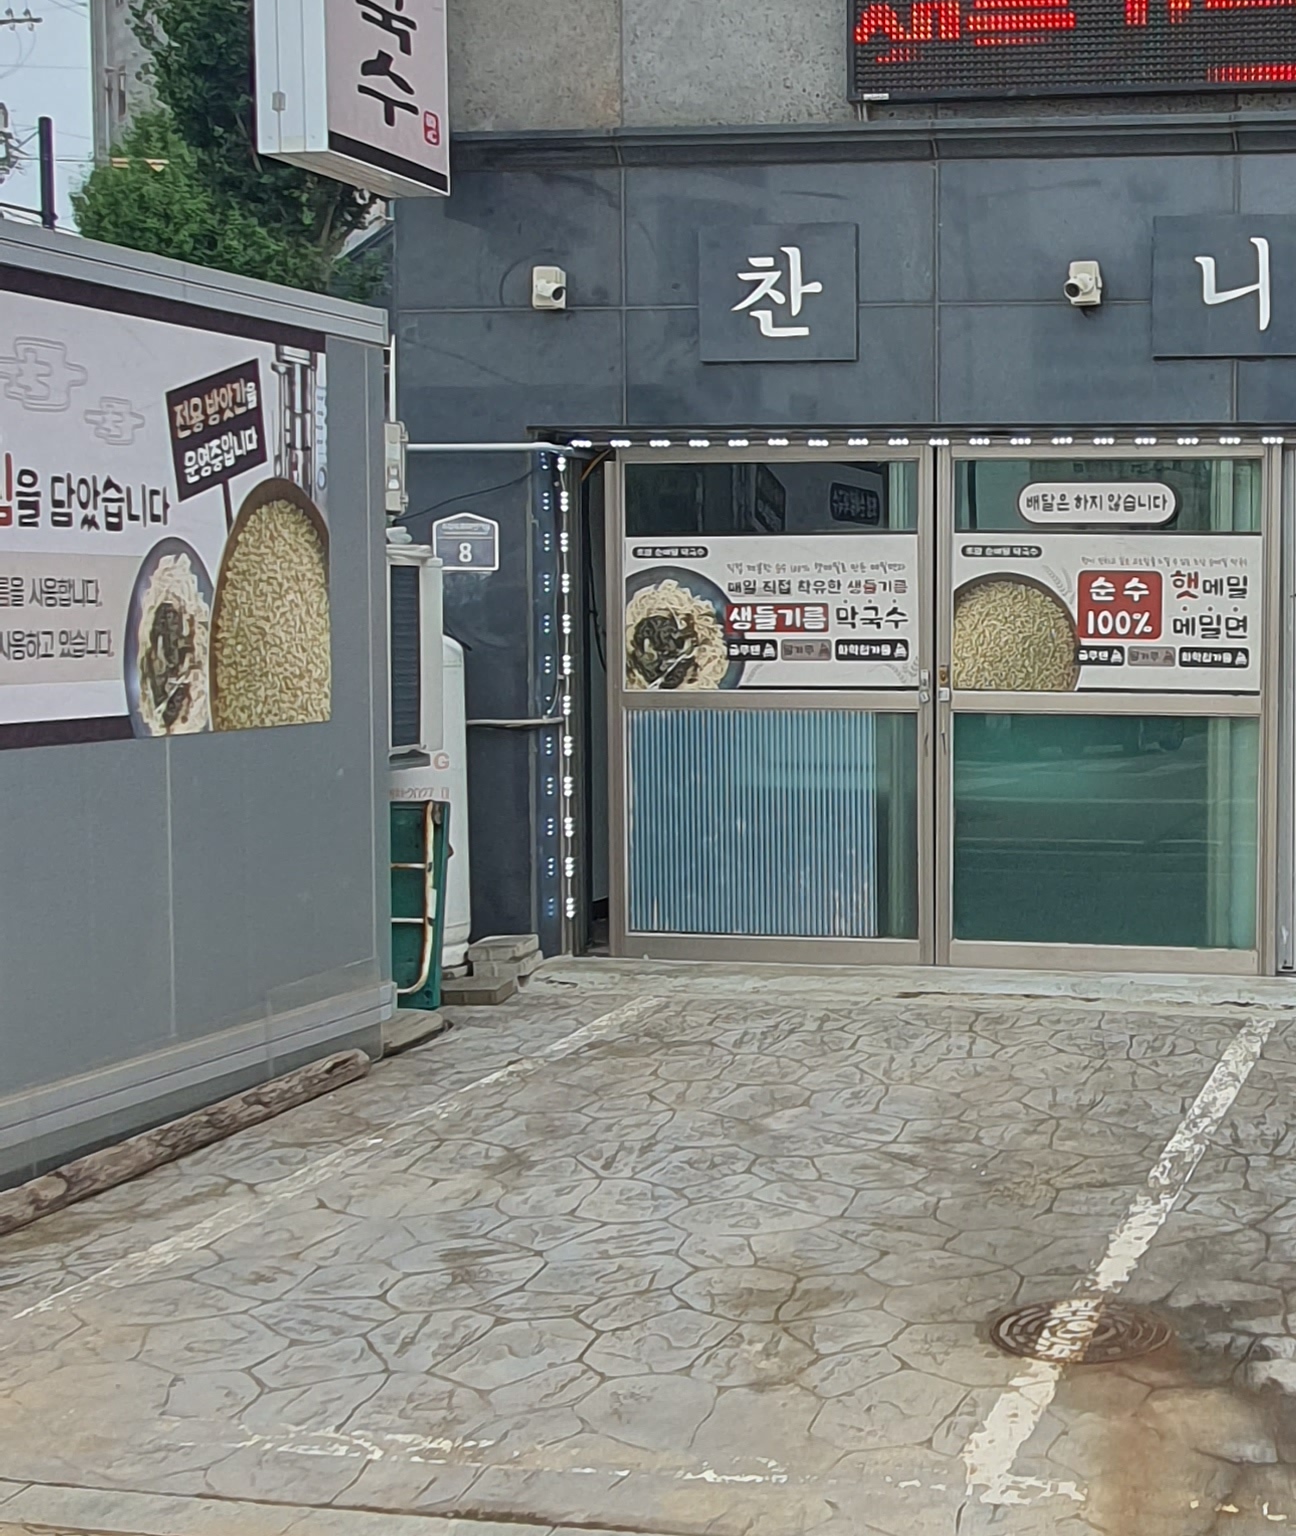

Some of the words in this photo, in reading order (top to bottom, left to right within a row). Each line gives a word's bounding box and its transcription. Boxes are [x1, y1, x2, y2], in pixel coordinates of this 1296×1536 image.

[731, 246, 822, 337] 찬
[1194, 237, 1270, 331] 니
[173, 396, 205, 439] 전용
[205, 378, 258, 425] 방앗간을
[184, 425, 259, 484] 운영중입니다
[50, 472, 171, 532] 담았습니다
[1026, 493, 1070, 512] 배달은
[1074, 493, 1103, 512] 하지
[1108, 493, 1168, 513] 않습니다
[459, 543, 472, 563] 8
[28, 577, 103, 608] 사용합니다.
[728, 579, 757, 595] 매일
[763, 579, 791, 595] 직접
[798, 579, 842, 595] 착유한
[847, 579, 908, 595] 생들기름
[1090, 576, 1149, 602] 순수
[1170, 570, 1248, 600] 햇메밀
[729, 605, 827, 631] 생들기름
[836, 605, 909, 630] 막국수
[1088, 610, 1152, 635] 100%
[1173, 613, 1248, 640] 메밀면
[58, 629, 115, 659] 있습니다.
